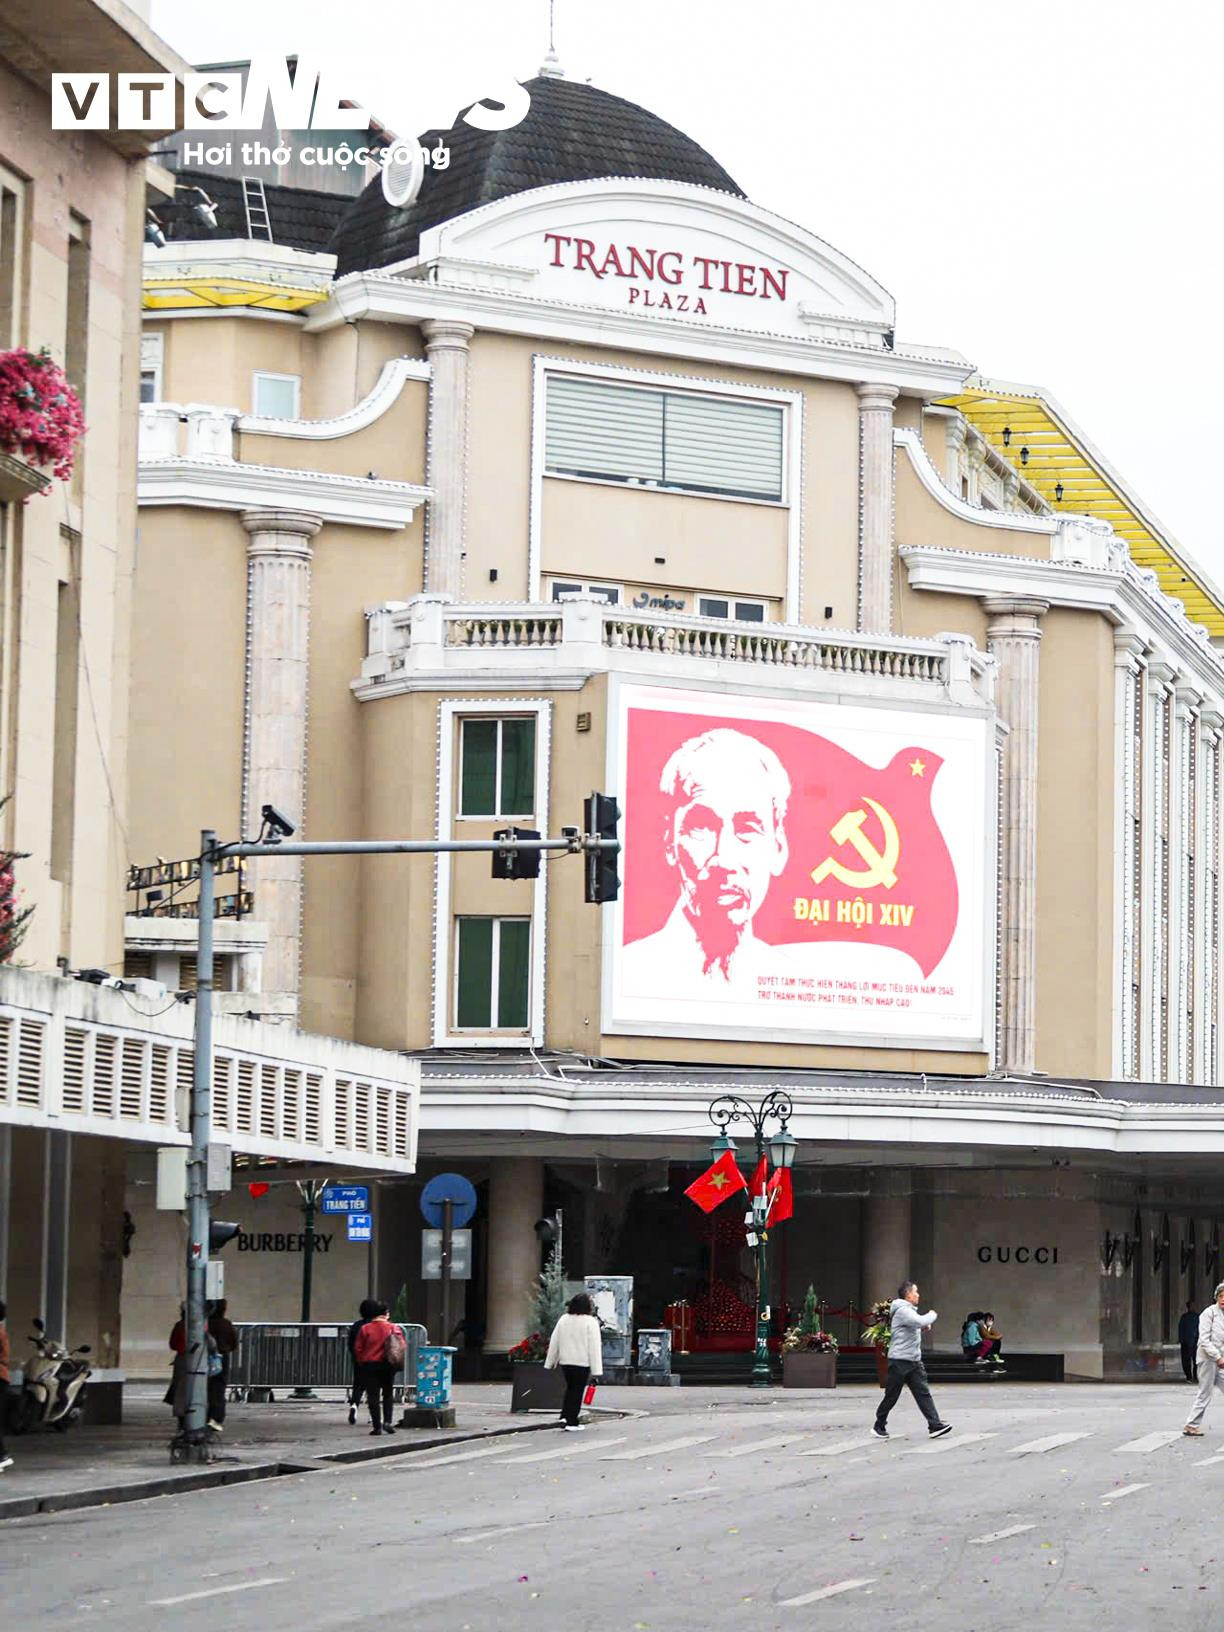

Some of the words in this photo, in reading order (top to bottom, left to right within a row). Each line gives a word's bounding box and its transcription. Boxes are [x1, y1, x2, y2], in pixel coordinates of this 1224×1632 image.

[544, 232, 684, 285] TRANG
[693, 256, 790, 301] TIEN
[628, 287, 708, 315] PLAZA
[793, 897, 830, 926] ĐẠI
[836, 896, 873, 929] HỘI
[879, 903, 914, 927] XIV
[237, 1233, 334, 1252] BURBERRY
[977, 1246, 1058, 1264] GUCCI
